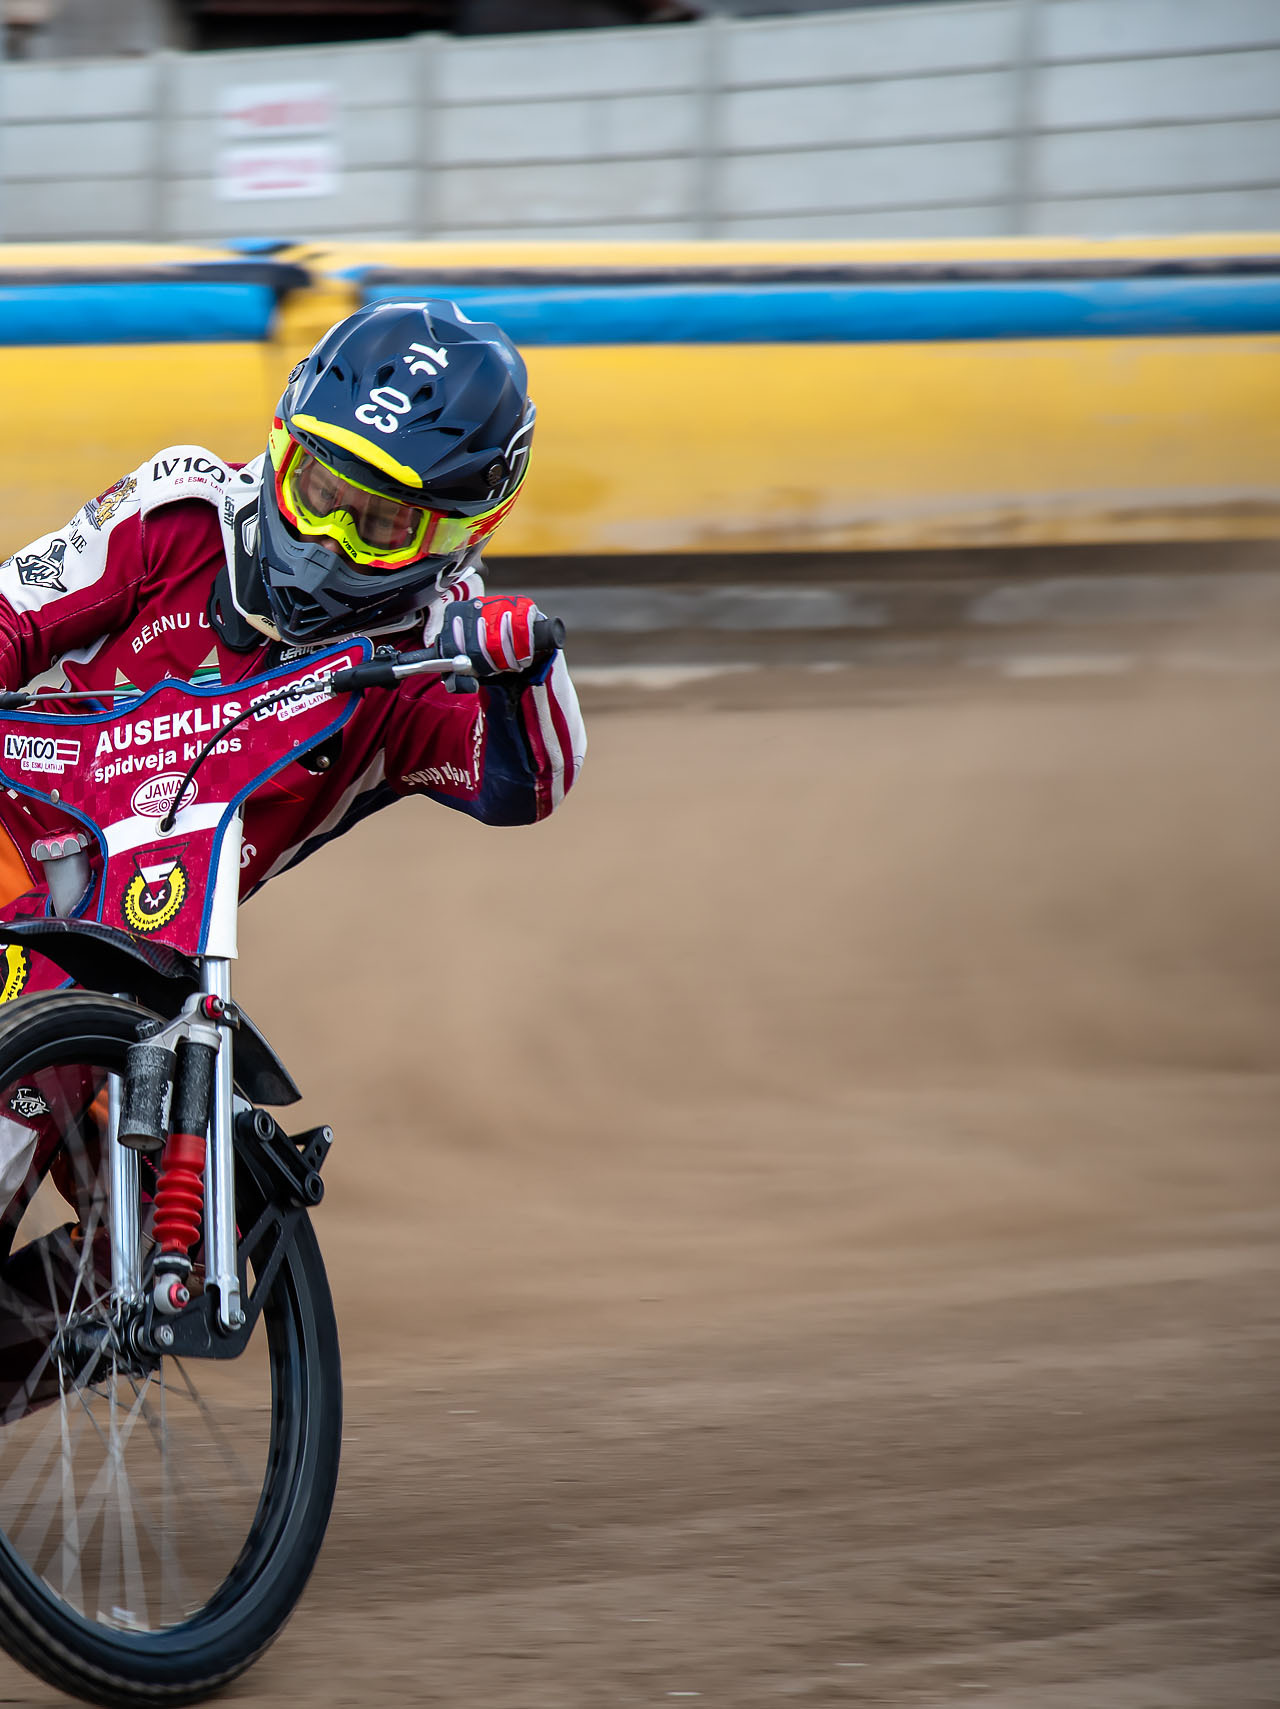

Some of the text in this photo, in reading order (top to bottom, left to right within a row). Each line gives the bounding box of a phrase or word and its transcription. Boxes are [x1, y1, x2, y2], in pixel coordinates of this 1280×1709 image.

[131, 612, 191, 655] BĒRNU
[95, 702, 242, 758] AUSEKLIS
[94, 748, 177, 784] spīdveja
